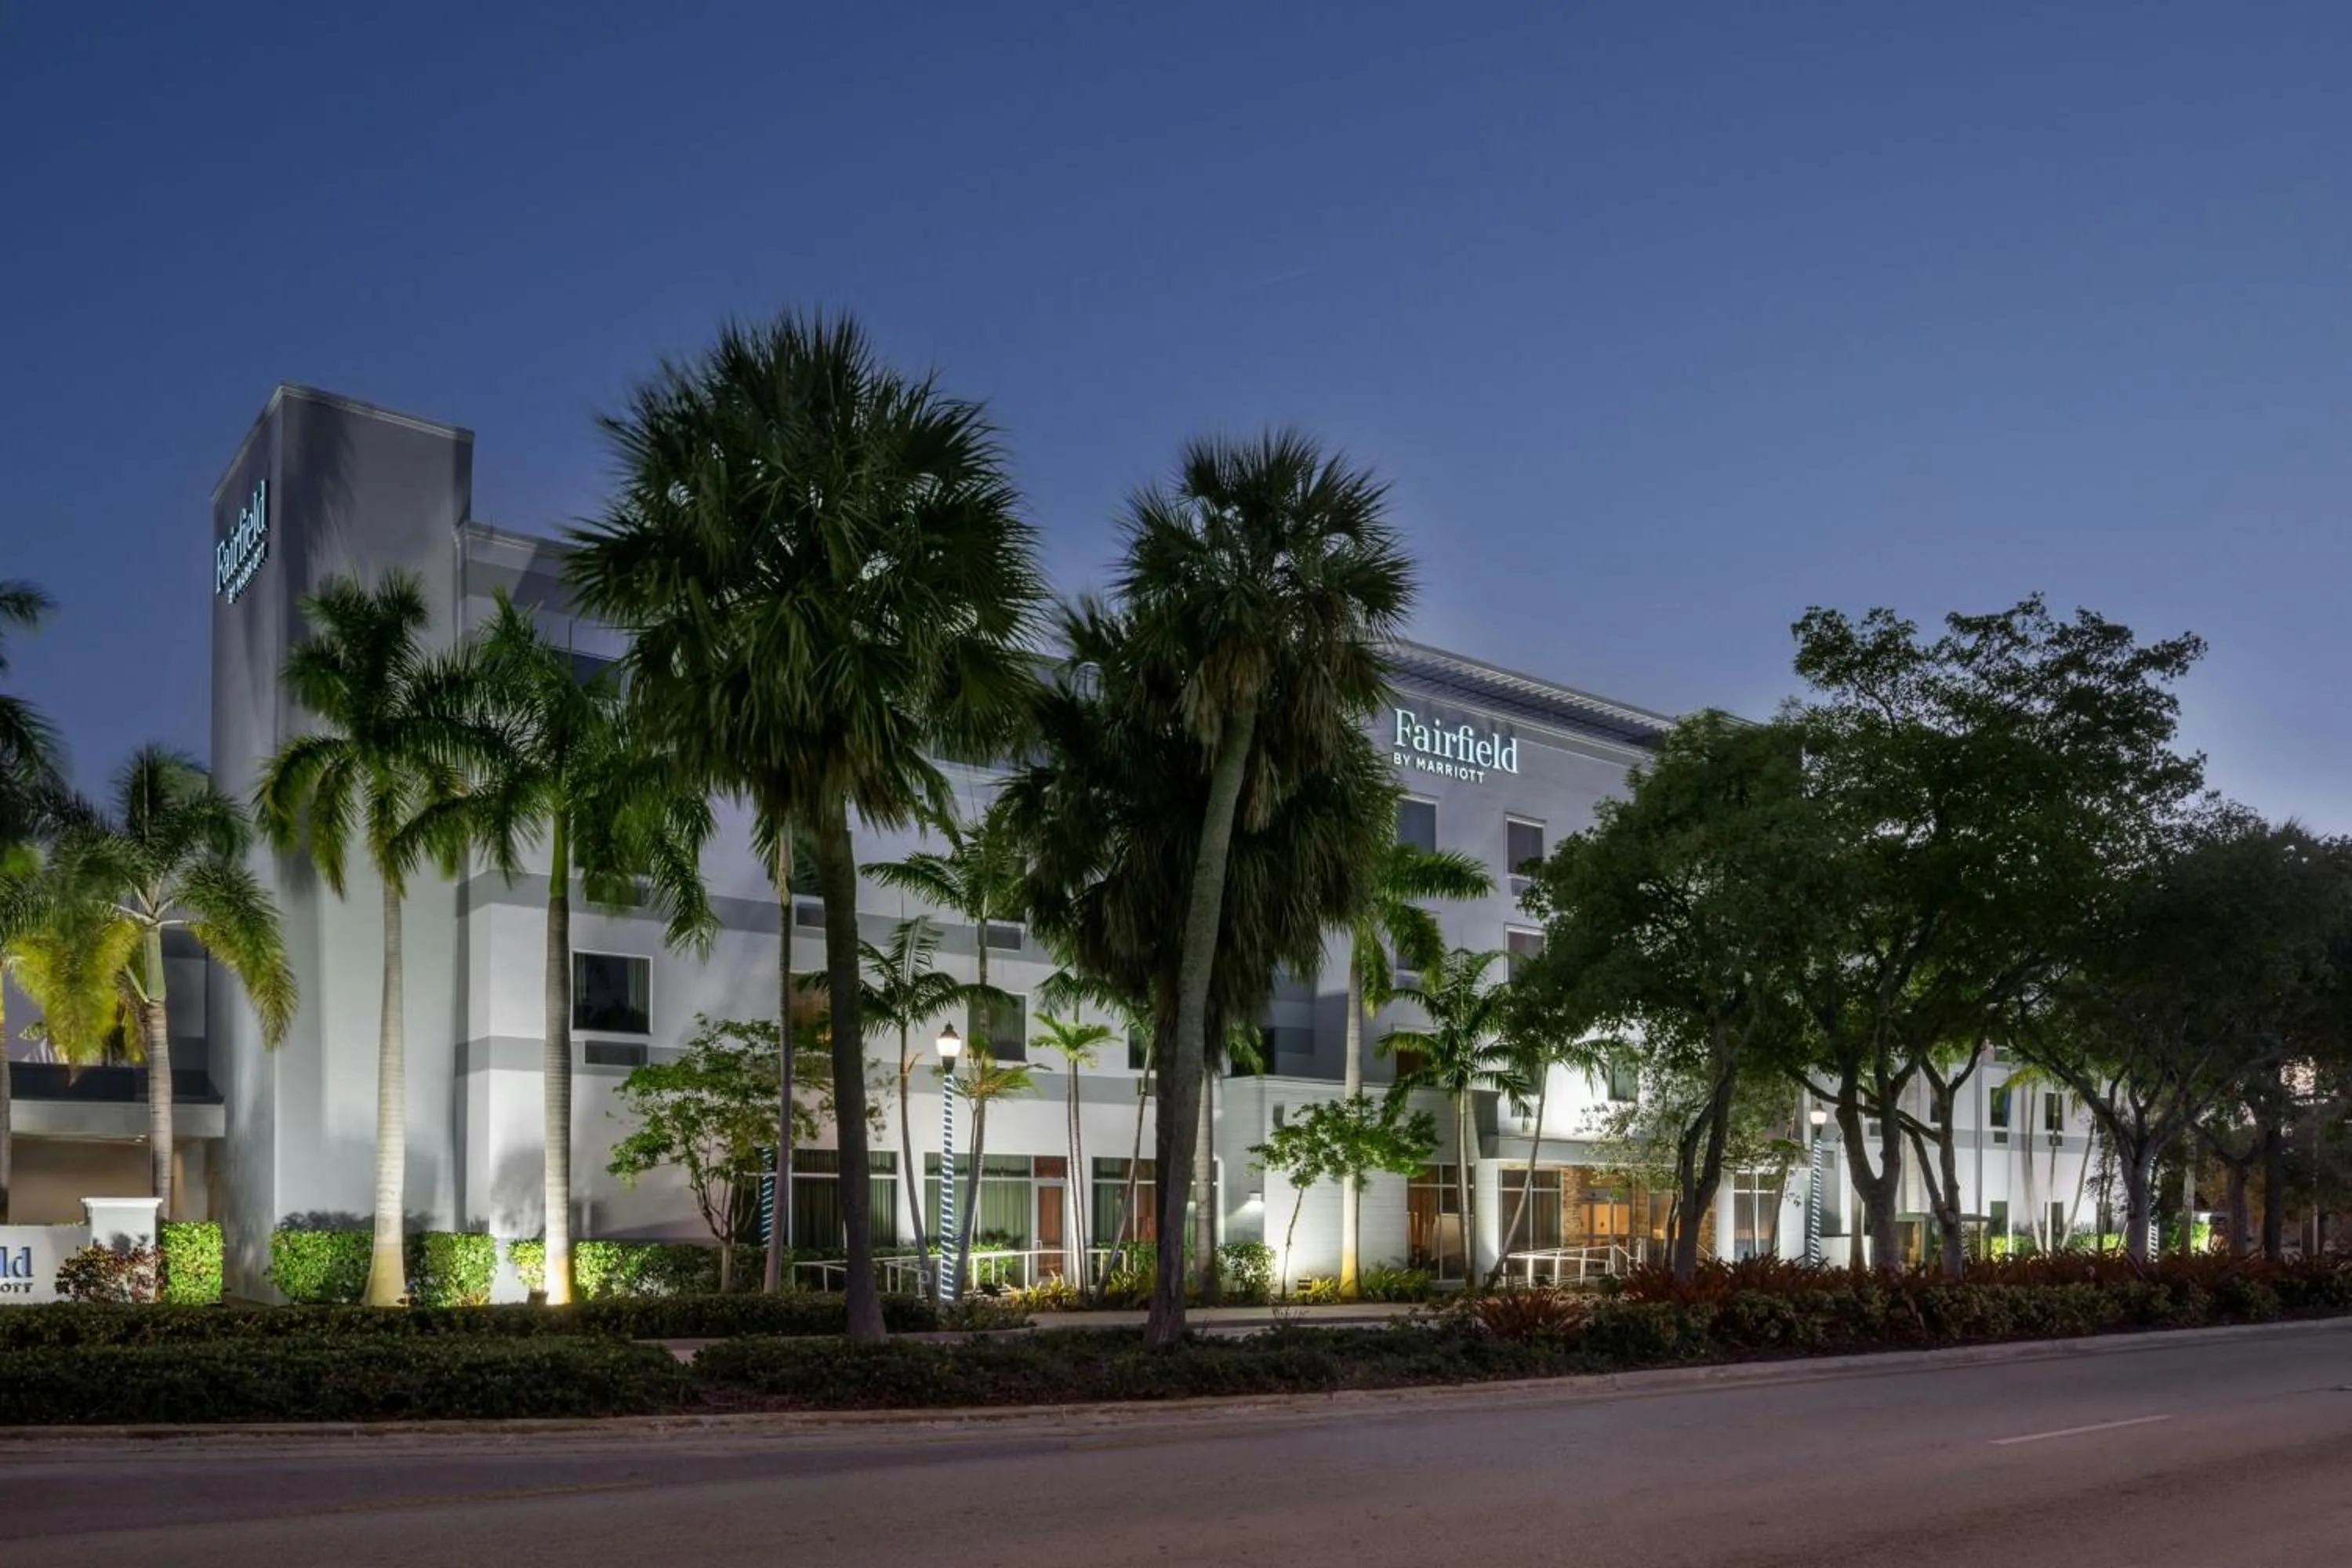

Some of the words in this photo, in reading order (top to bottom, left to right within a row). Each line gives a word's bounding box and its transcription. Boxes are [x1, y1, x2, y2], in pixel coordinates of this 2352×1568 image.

[216, 479, 268, 594] Fairfield
[1393, 708, 1518, 774] Fairfield
[1393, 752, 1410, 766] BY
[1416, 757, 1486, 784] MARRIOTT
